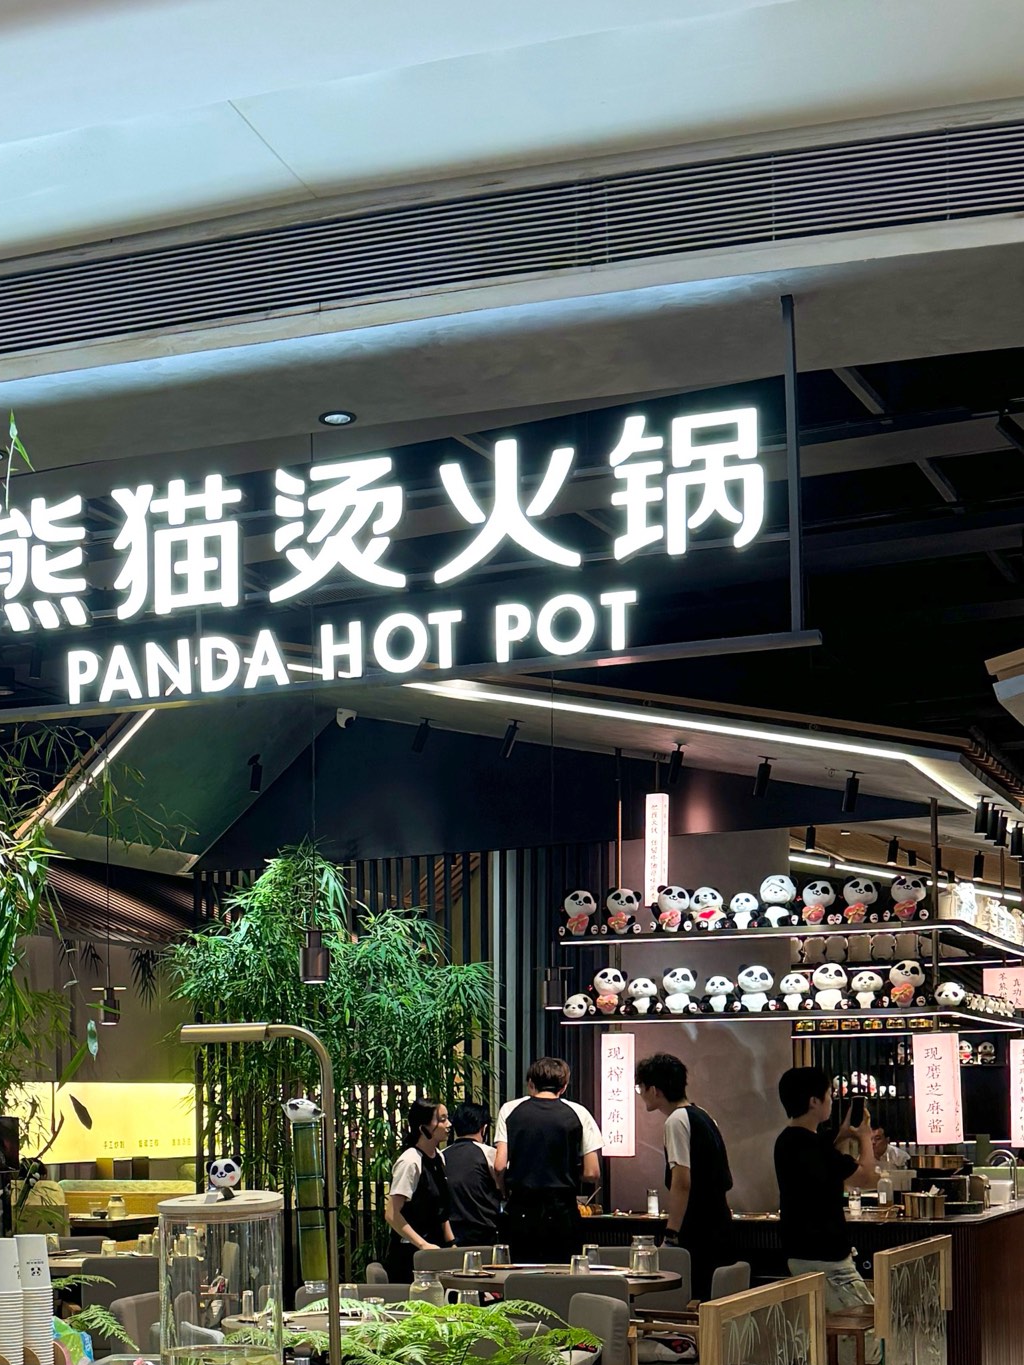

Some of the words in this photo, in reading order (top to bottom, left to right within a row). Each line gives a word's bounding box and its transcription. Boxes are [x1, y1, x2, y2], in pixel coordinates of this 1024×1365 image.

[66, 629, 291, 705] PANDA
[319, 609, 464, 681] HOT
[493, 591, 636, 663] POT
[607, 1046, 625, 1144] 现榨芝麻油
[924, 1046, 945, 1134] 现磨芝麻酱
